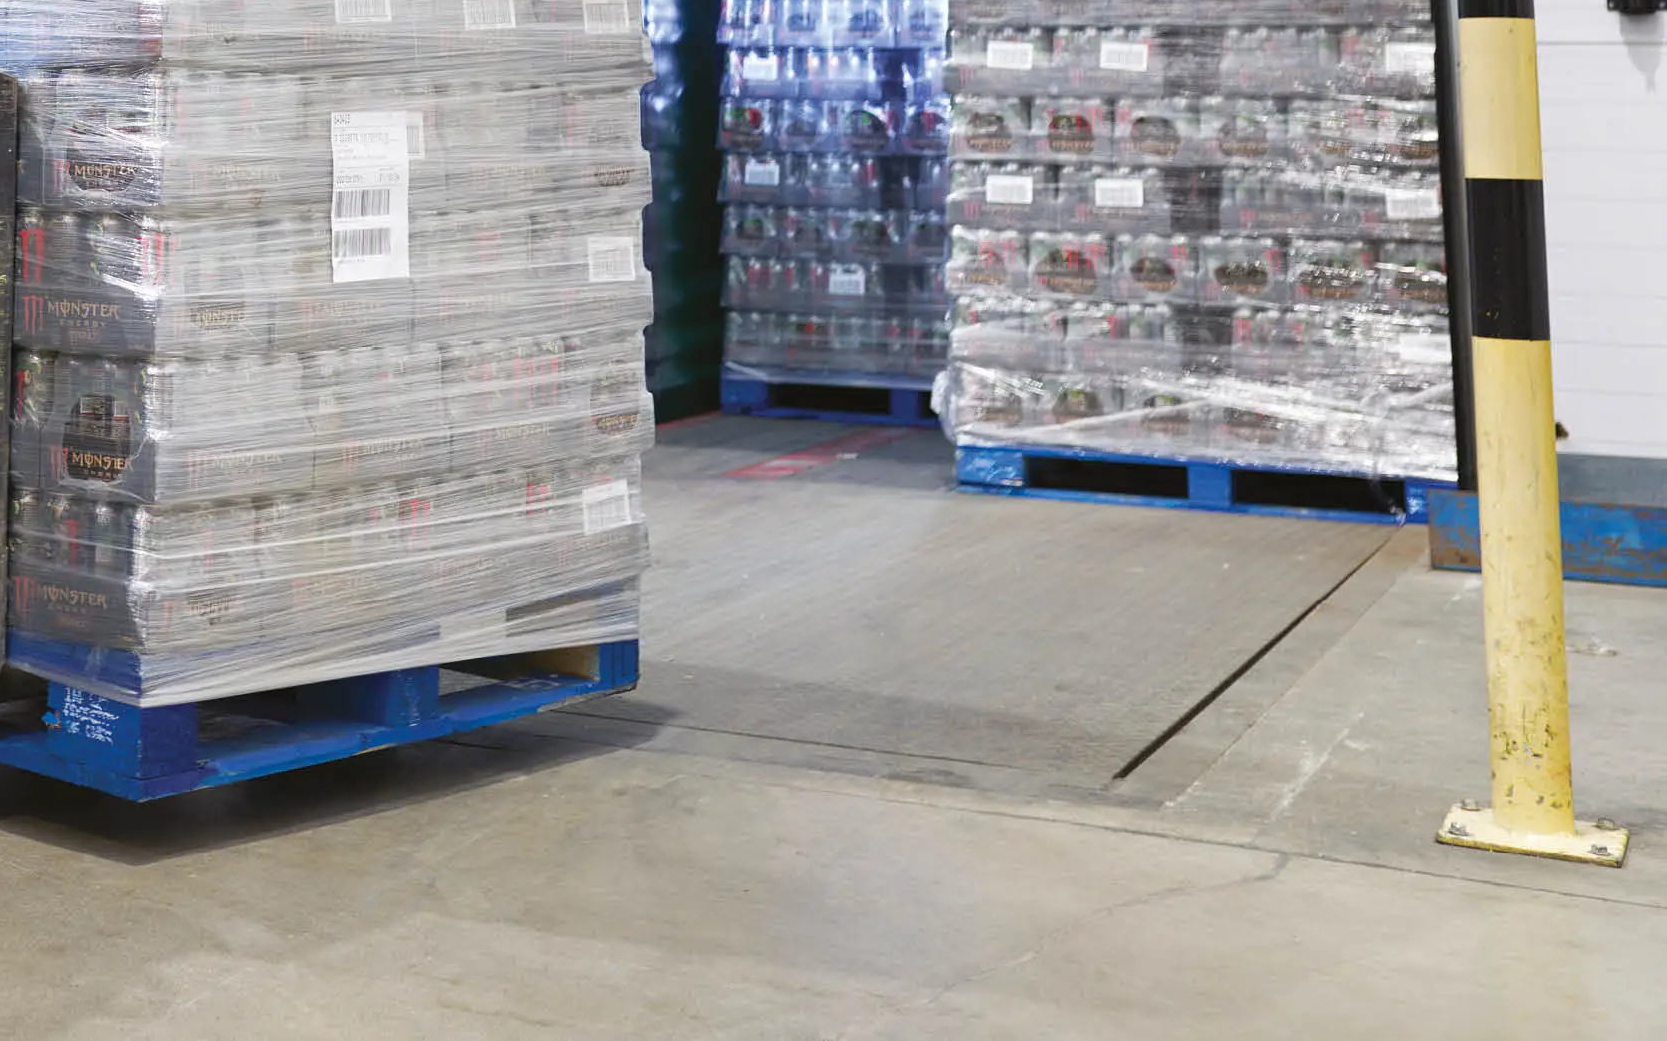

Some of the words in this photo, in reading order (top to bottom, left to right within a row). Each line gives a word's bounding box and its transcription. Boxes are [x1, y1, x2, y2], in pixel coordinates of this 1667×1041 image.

[47, 297, 121, 320] MONSTER
[72, 451, 134, 473] MONSTER
[36, 582, 108, 610] MONSTER
